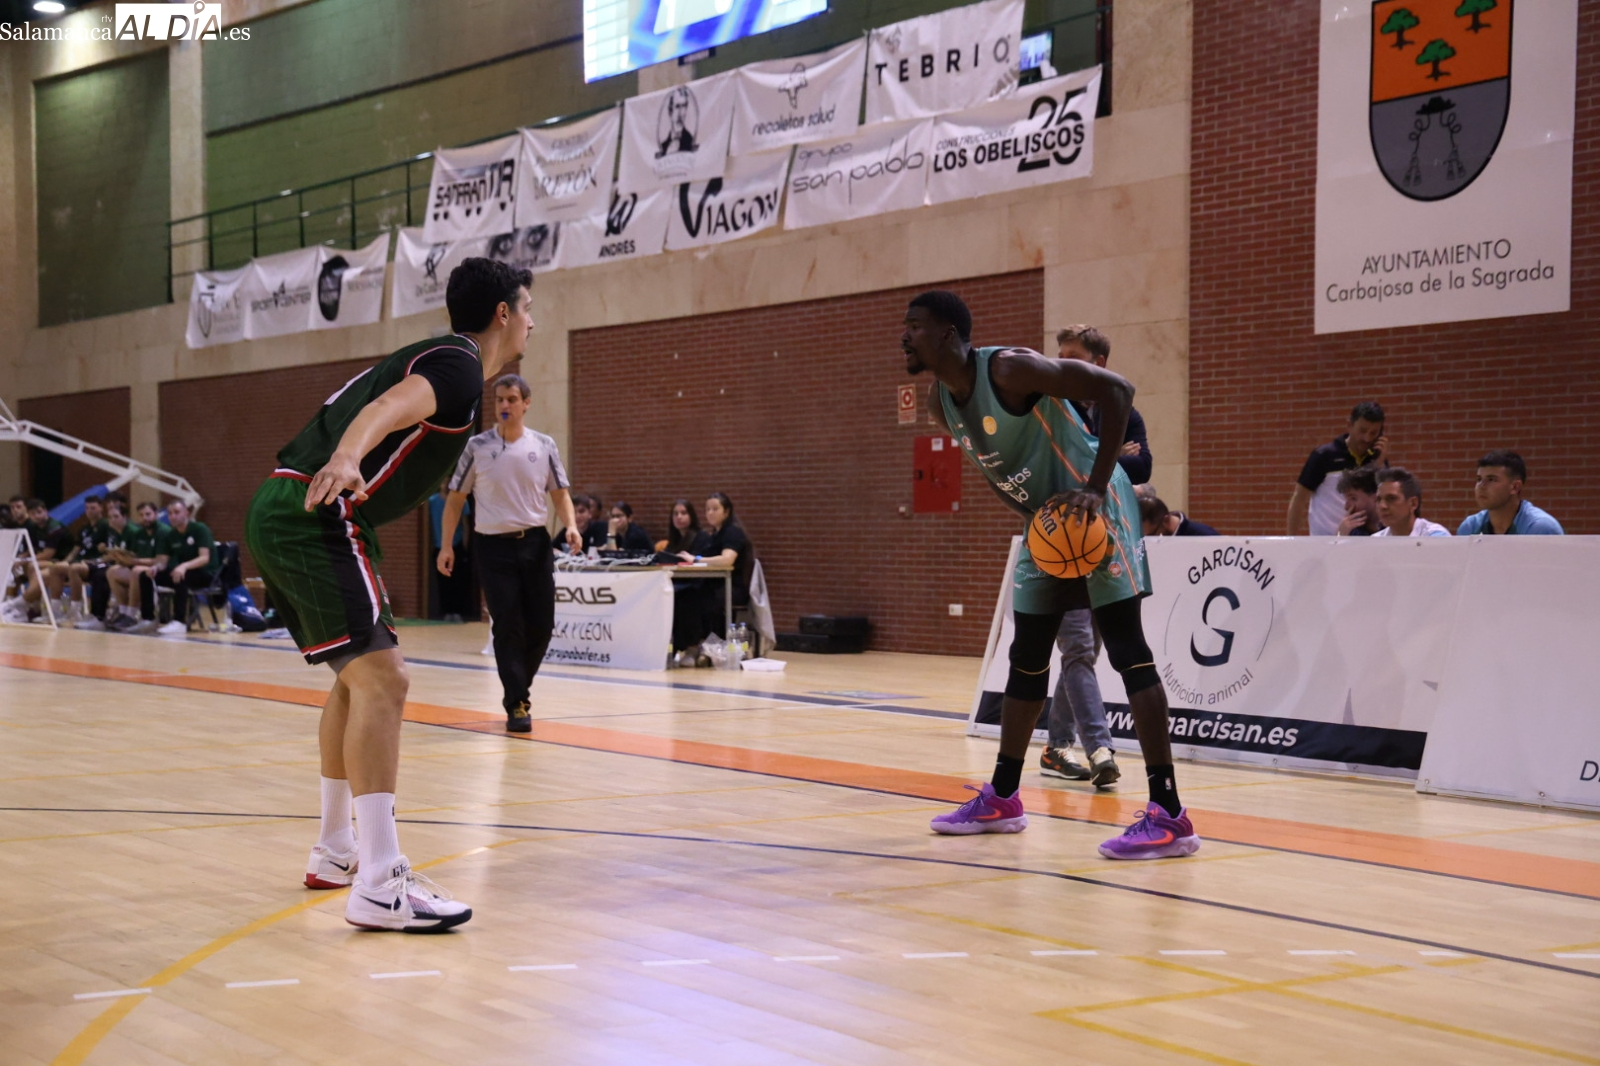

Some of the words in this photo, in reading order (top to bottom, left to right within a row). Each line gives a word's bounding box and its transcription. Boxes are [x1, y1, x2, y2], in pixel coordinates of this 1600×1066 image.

[798, 142, 853, 171] grupo
[934, 148, 967, 173] LOS
[973, 124, 1085, 165] OBELISCOS
[793, 170, 842, 193] san
[849, 138, 924, 205] pablo
[1361, 238, 1512, 275] AYUNTAMIENTO
[1326, 279, 1413, 303] Carbajosa
[1420, 272, 1442, 293] de
[1449, 270, 1465, 290] la
[1472, 259, 1555, 290] Sagrada
[1187, 546, 1275, 591] GARCISAN
[554, 586, 617, 605] EXUS
[1162, 662, 1204, 706] Nutrición
[1208, 667, 1254, 706] animal
